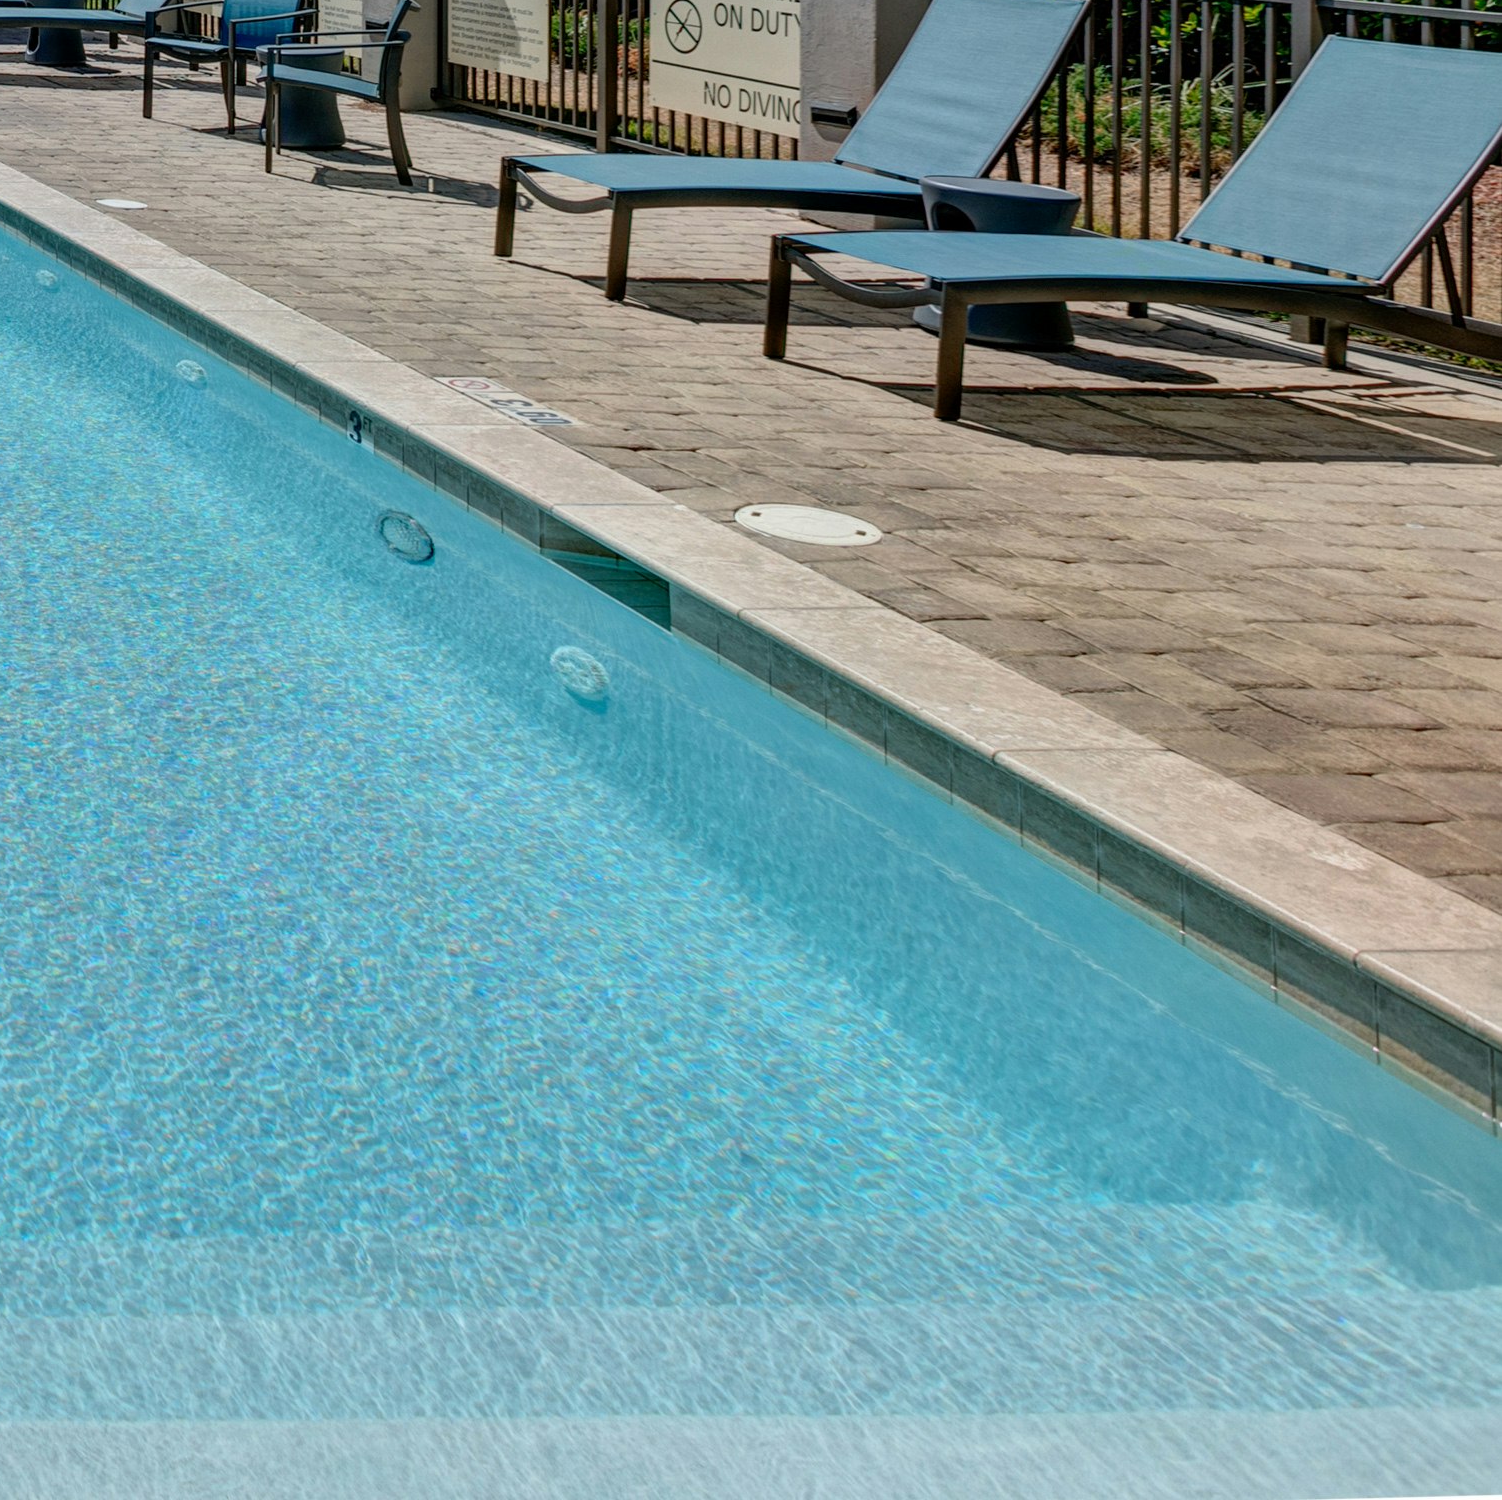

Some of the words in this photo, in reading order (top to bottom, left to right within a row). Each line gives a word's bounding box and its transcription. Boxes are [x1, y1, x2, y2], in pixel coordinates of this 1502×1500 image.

[714, 3, 743, 30] ON
[704, 81, 731, 108] NO
[350, 410, 362, 444] 3
